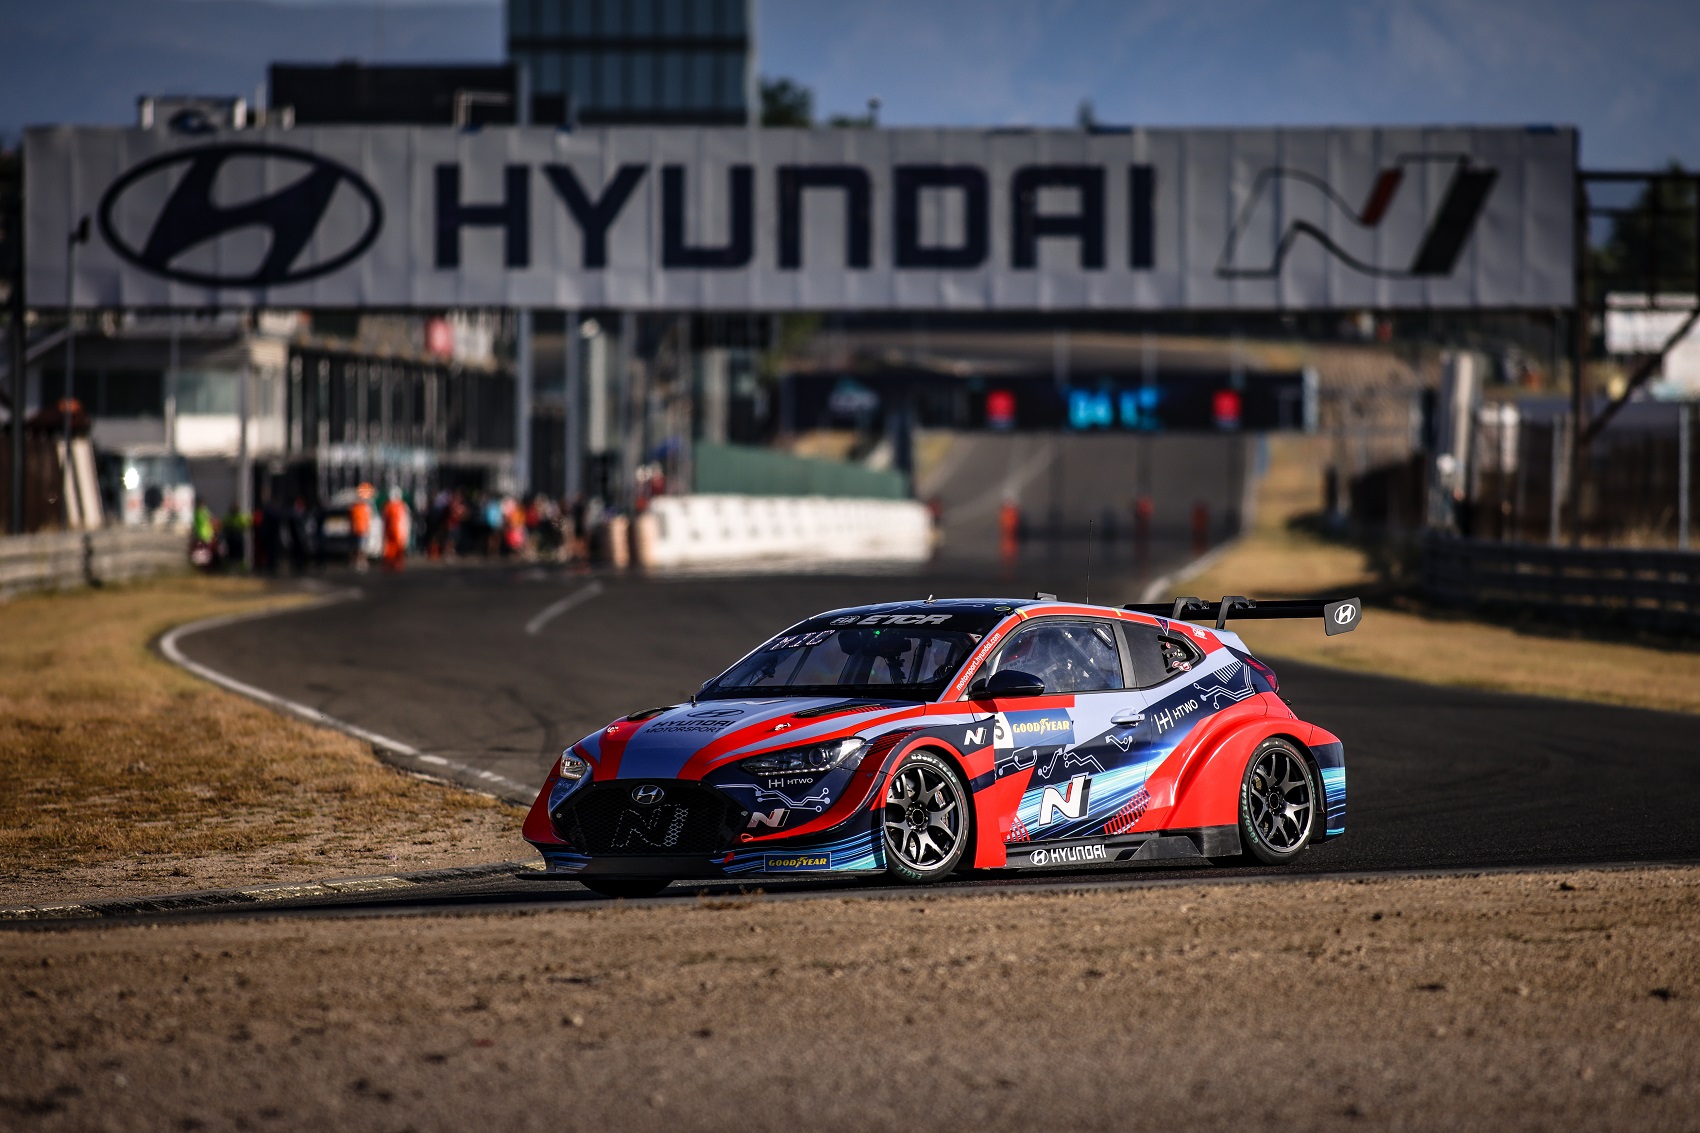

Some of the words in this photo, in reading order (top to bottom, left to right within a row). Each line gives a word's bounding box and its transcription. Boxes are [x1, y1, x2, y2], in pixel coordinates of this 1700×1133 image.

[434, 163, 1156, 269] HYUNDAI
[857, 614, 952, 625] ETCR
[956, 632, 1001, 691] motorsport.hyundai.com
[1172, 699, 1199, 719] HTWO
[643, 726, 725, 735] MOTORSPORT
[652, 720, 737, 728] HYUNDAI
[1012, 718, 1070, 735] GOODYEAR
[787, 777, 814, 785] HTWO
[1038, 771, 1093, 828] N
[1050, 844, 1107, 862] HYUNDAI
[768, 856, 828, 868] GOODYEAR
